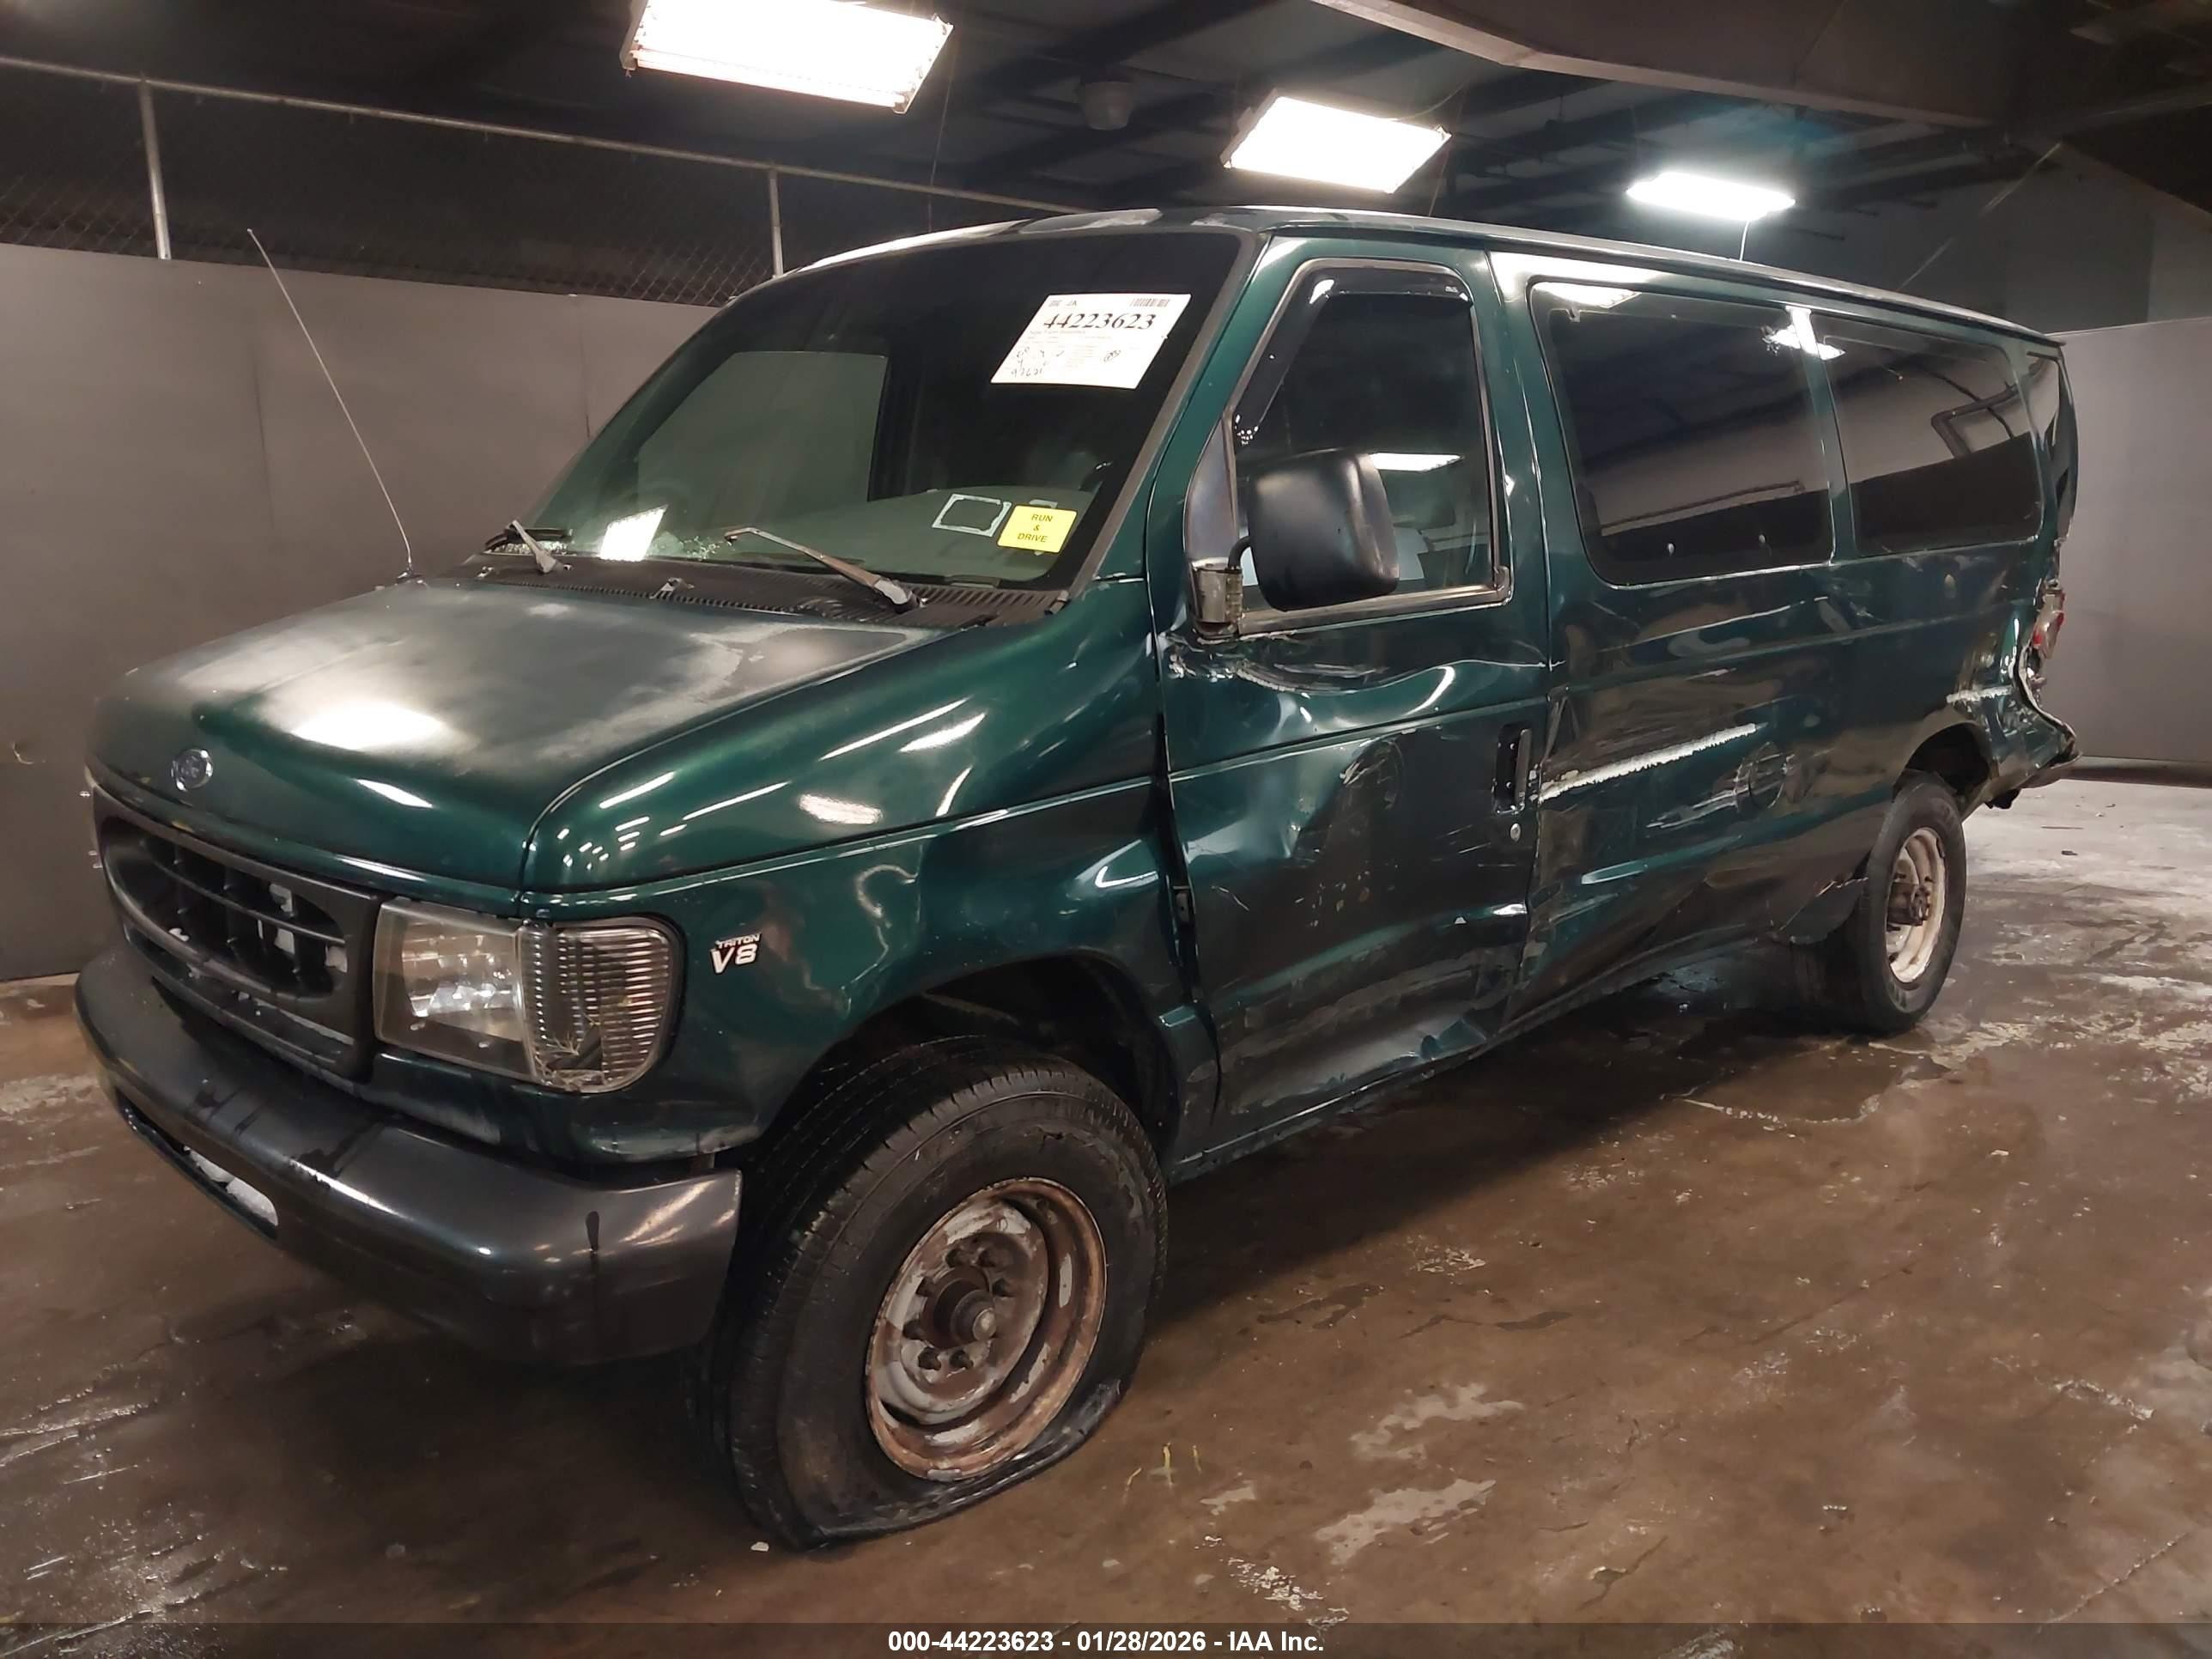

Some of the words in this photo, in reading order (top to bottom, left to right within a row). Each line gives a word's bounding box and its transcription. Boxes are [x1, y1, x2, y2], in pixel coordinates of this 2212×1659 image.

[1043, 313, 1157, 330] 44223623
[1031, 514, 1054, 522] RUN
[1018, 533, 1048, 543] DRIVE
[715, 933, 762, 950] TRITON
[710, 943, 758, 974] V8
